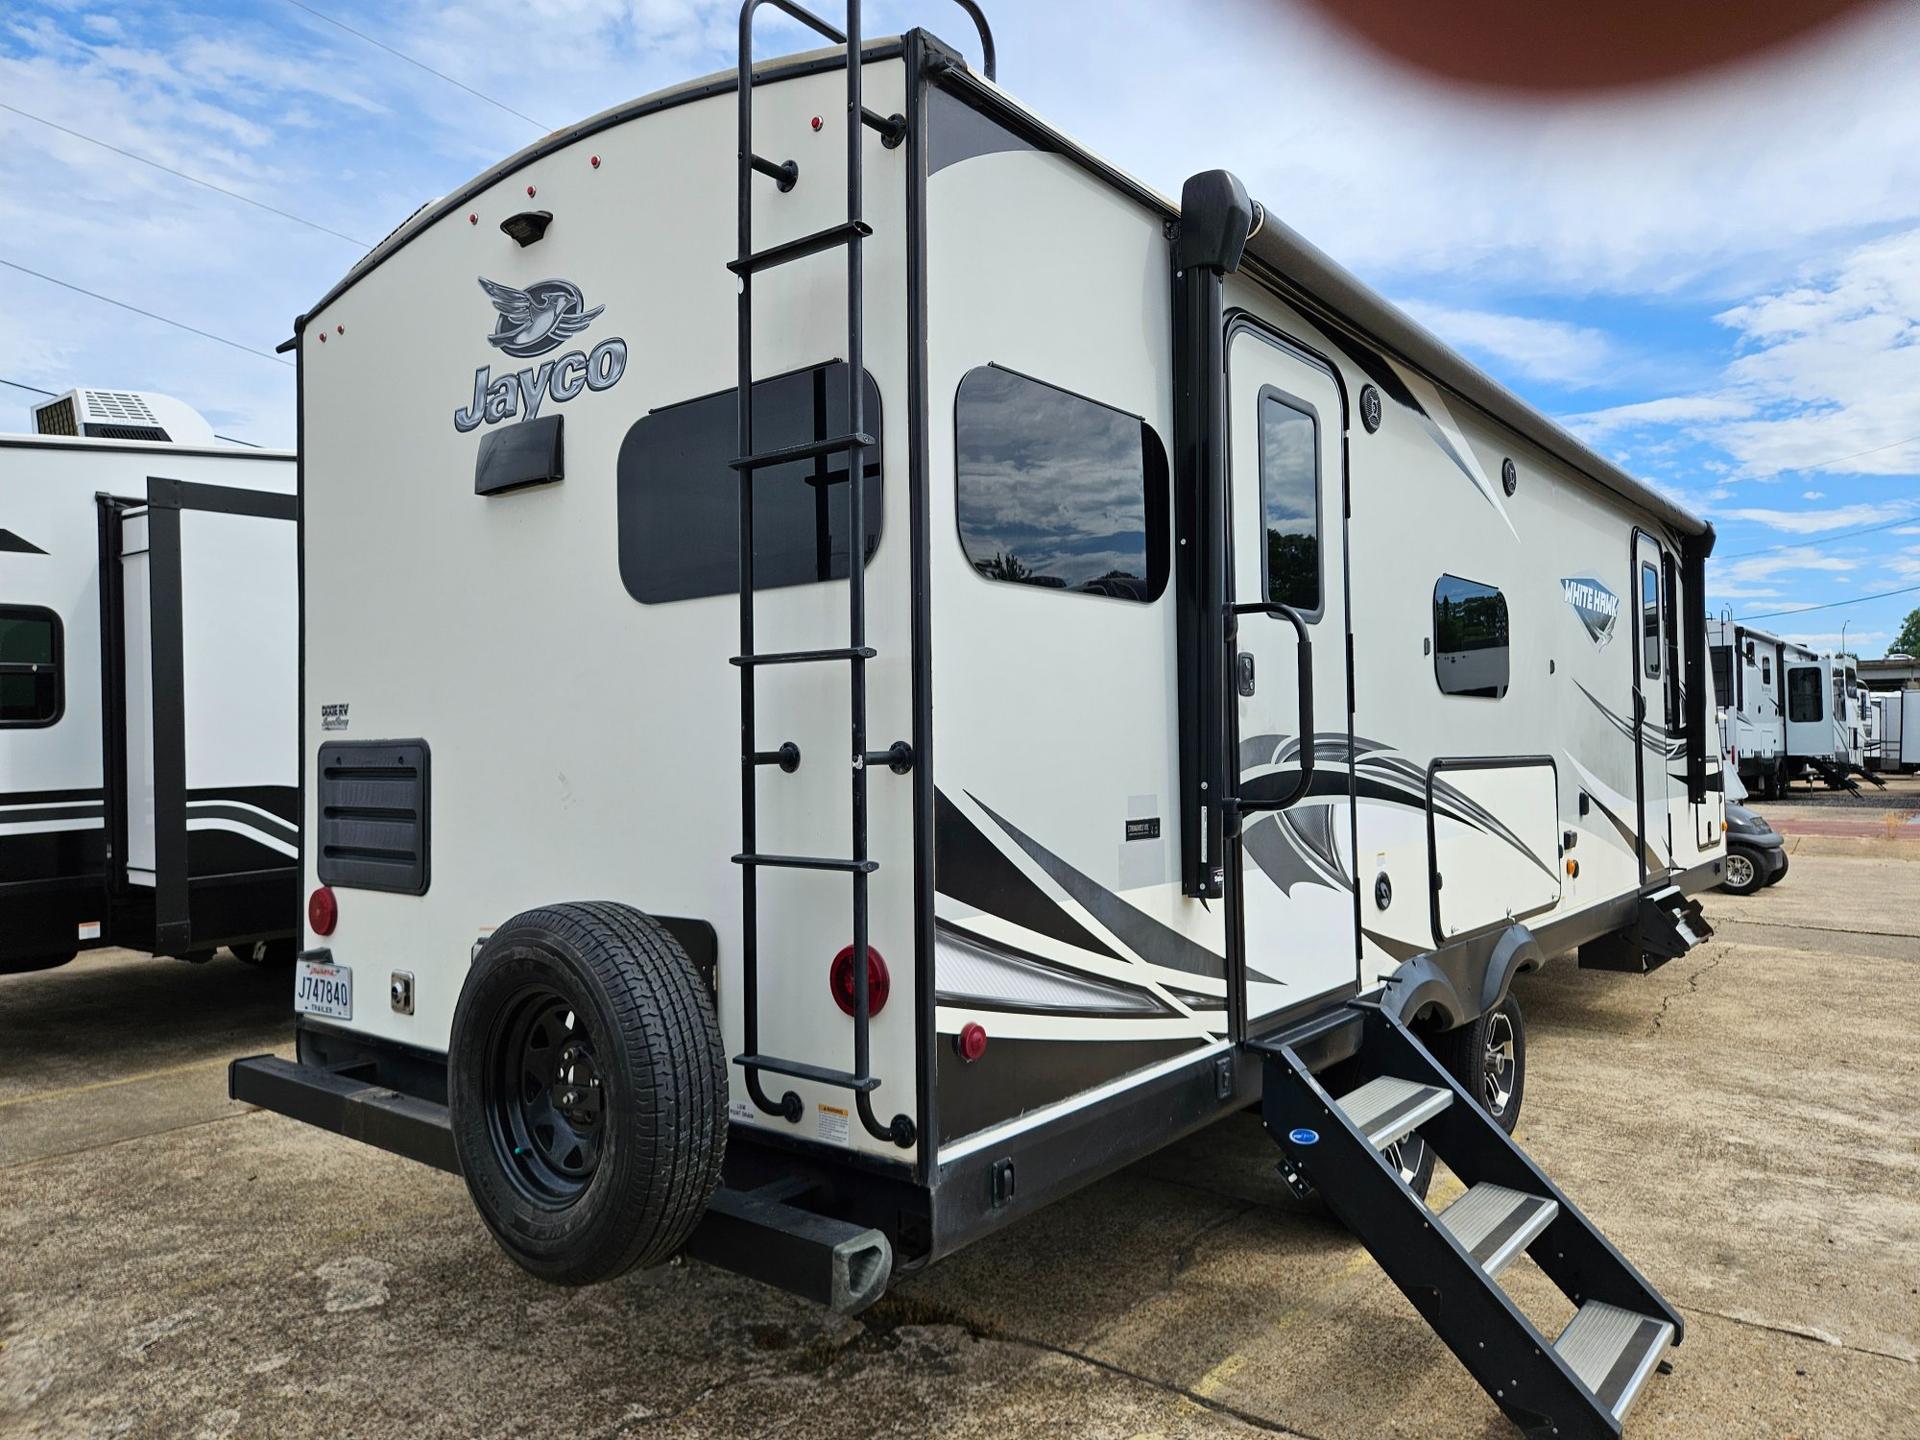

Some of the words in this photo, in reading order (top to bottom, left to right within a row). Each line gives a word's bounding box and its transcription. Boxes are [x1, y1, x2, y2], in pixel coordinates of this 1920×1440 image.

[454, 336, 628, 433] Jayco
[1564, 579, 1594, 610] WHITE
[1593, 589, 1618, 617] HAWK
[338, 703, 350, 716] RV
[298, 976, 348, 1007] J747840
[311, 1003, 332, 1014] TRAILER
